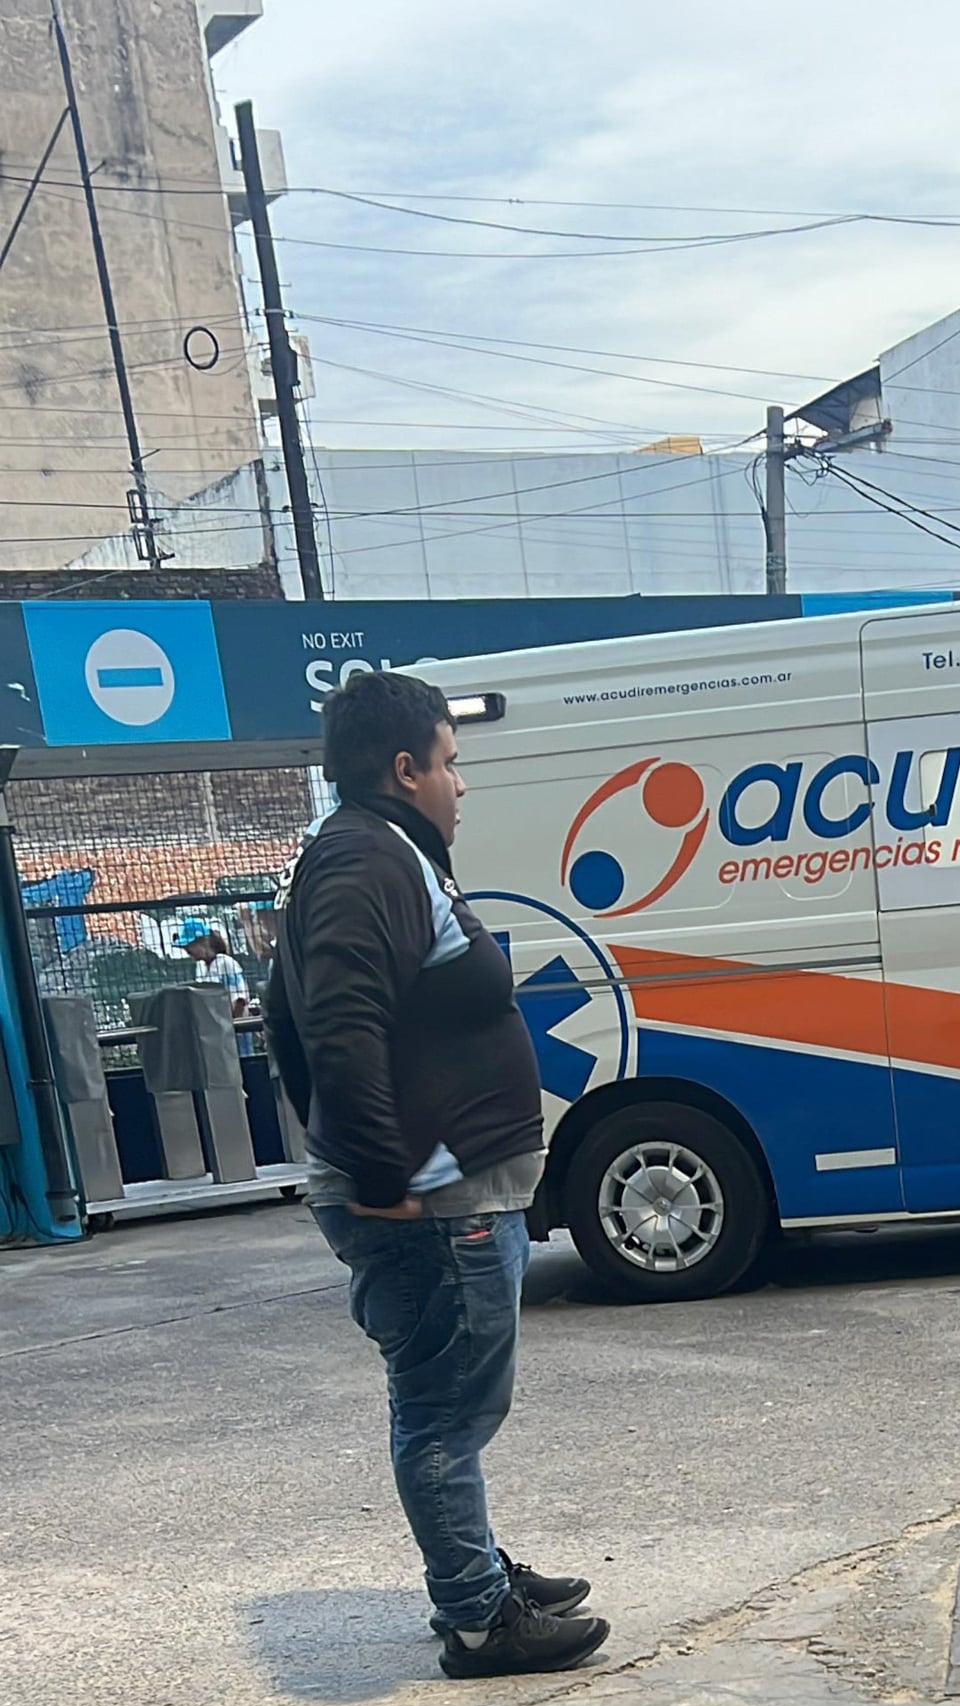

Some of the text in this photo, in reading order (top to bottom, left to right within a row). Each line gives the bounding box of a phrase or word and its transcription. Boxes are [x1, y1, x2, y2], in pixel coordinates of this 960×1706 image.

[302, 632, 364, 649] NO EXIT
[563, 671, 792, 705] www.acudiremergencias.com.ar
[718, 837, 941, 885] emergencias
